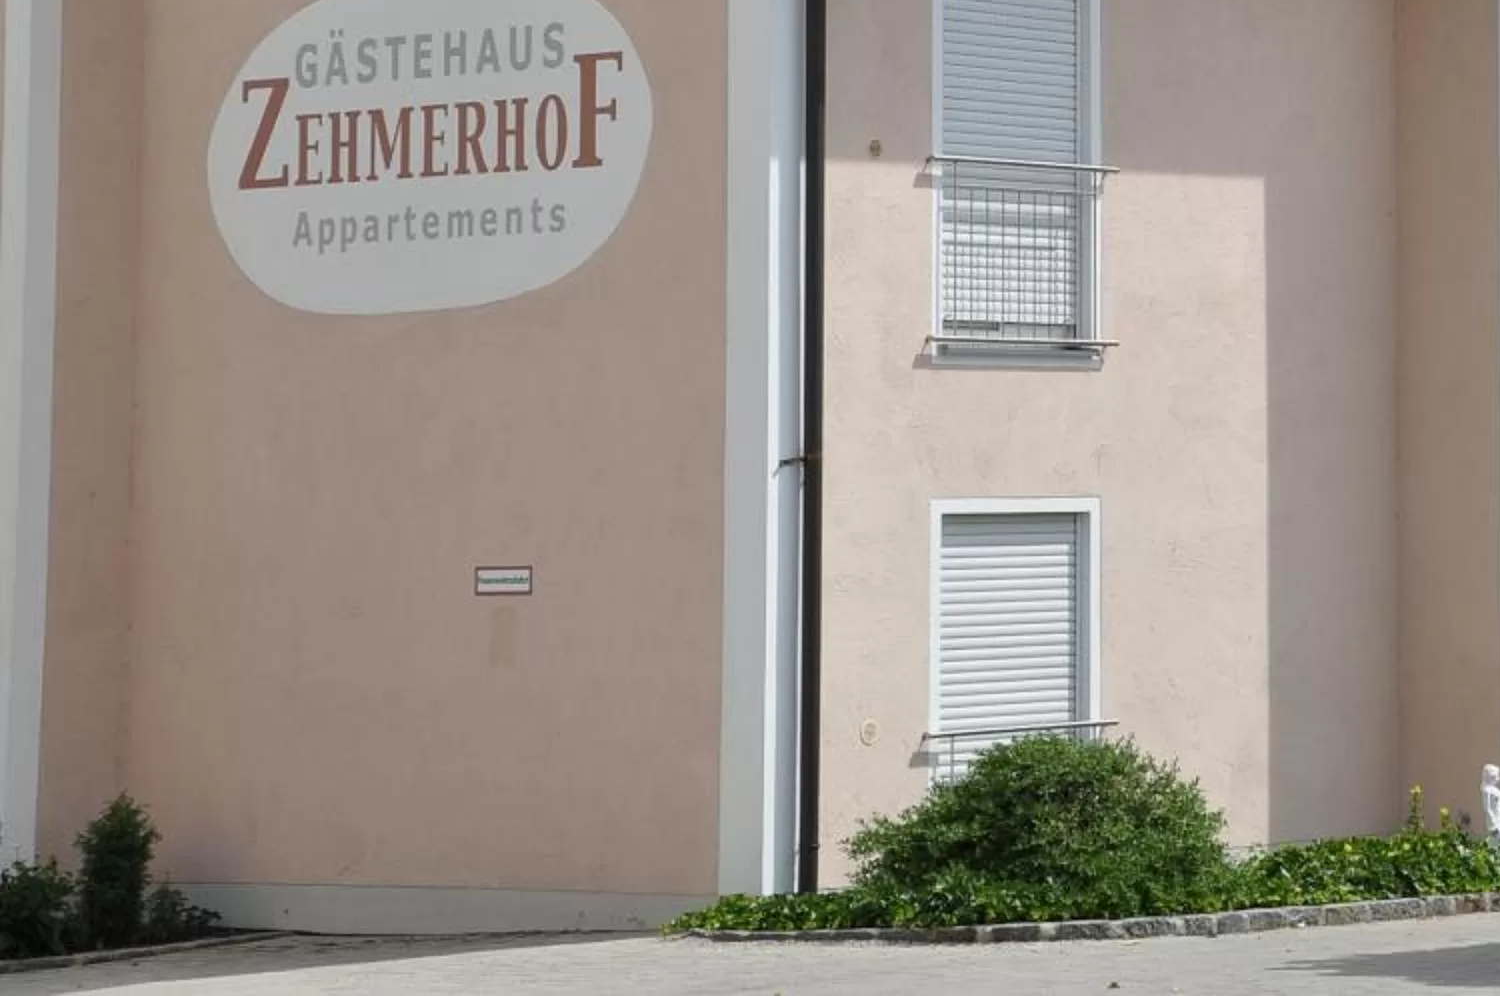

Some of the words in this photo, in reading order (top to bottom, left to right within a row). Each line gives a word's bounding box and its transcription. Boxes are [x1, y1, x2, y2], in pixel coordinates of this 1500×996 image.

[294, 22, 566, 89] GÄSTEHAUS
[237, 50, 623, 190] ZEHMERHOF
[292, 198, 567, 255] Appartements
